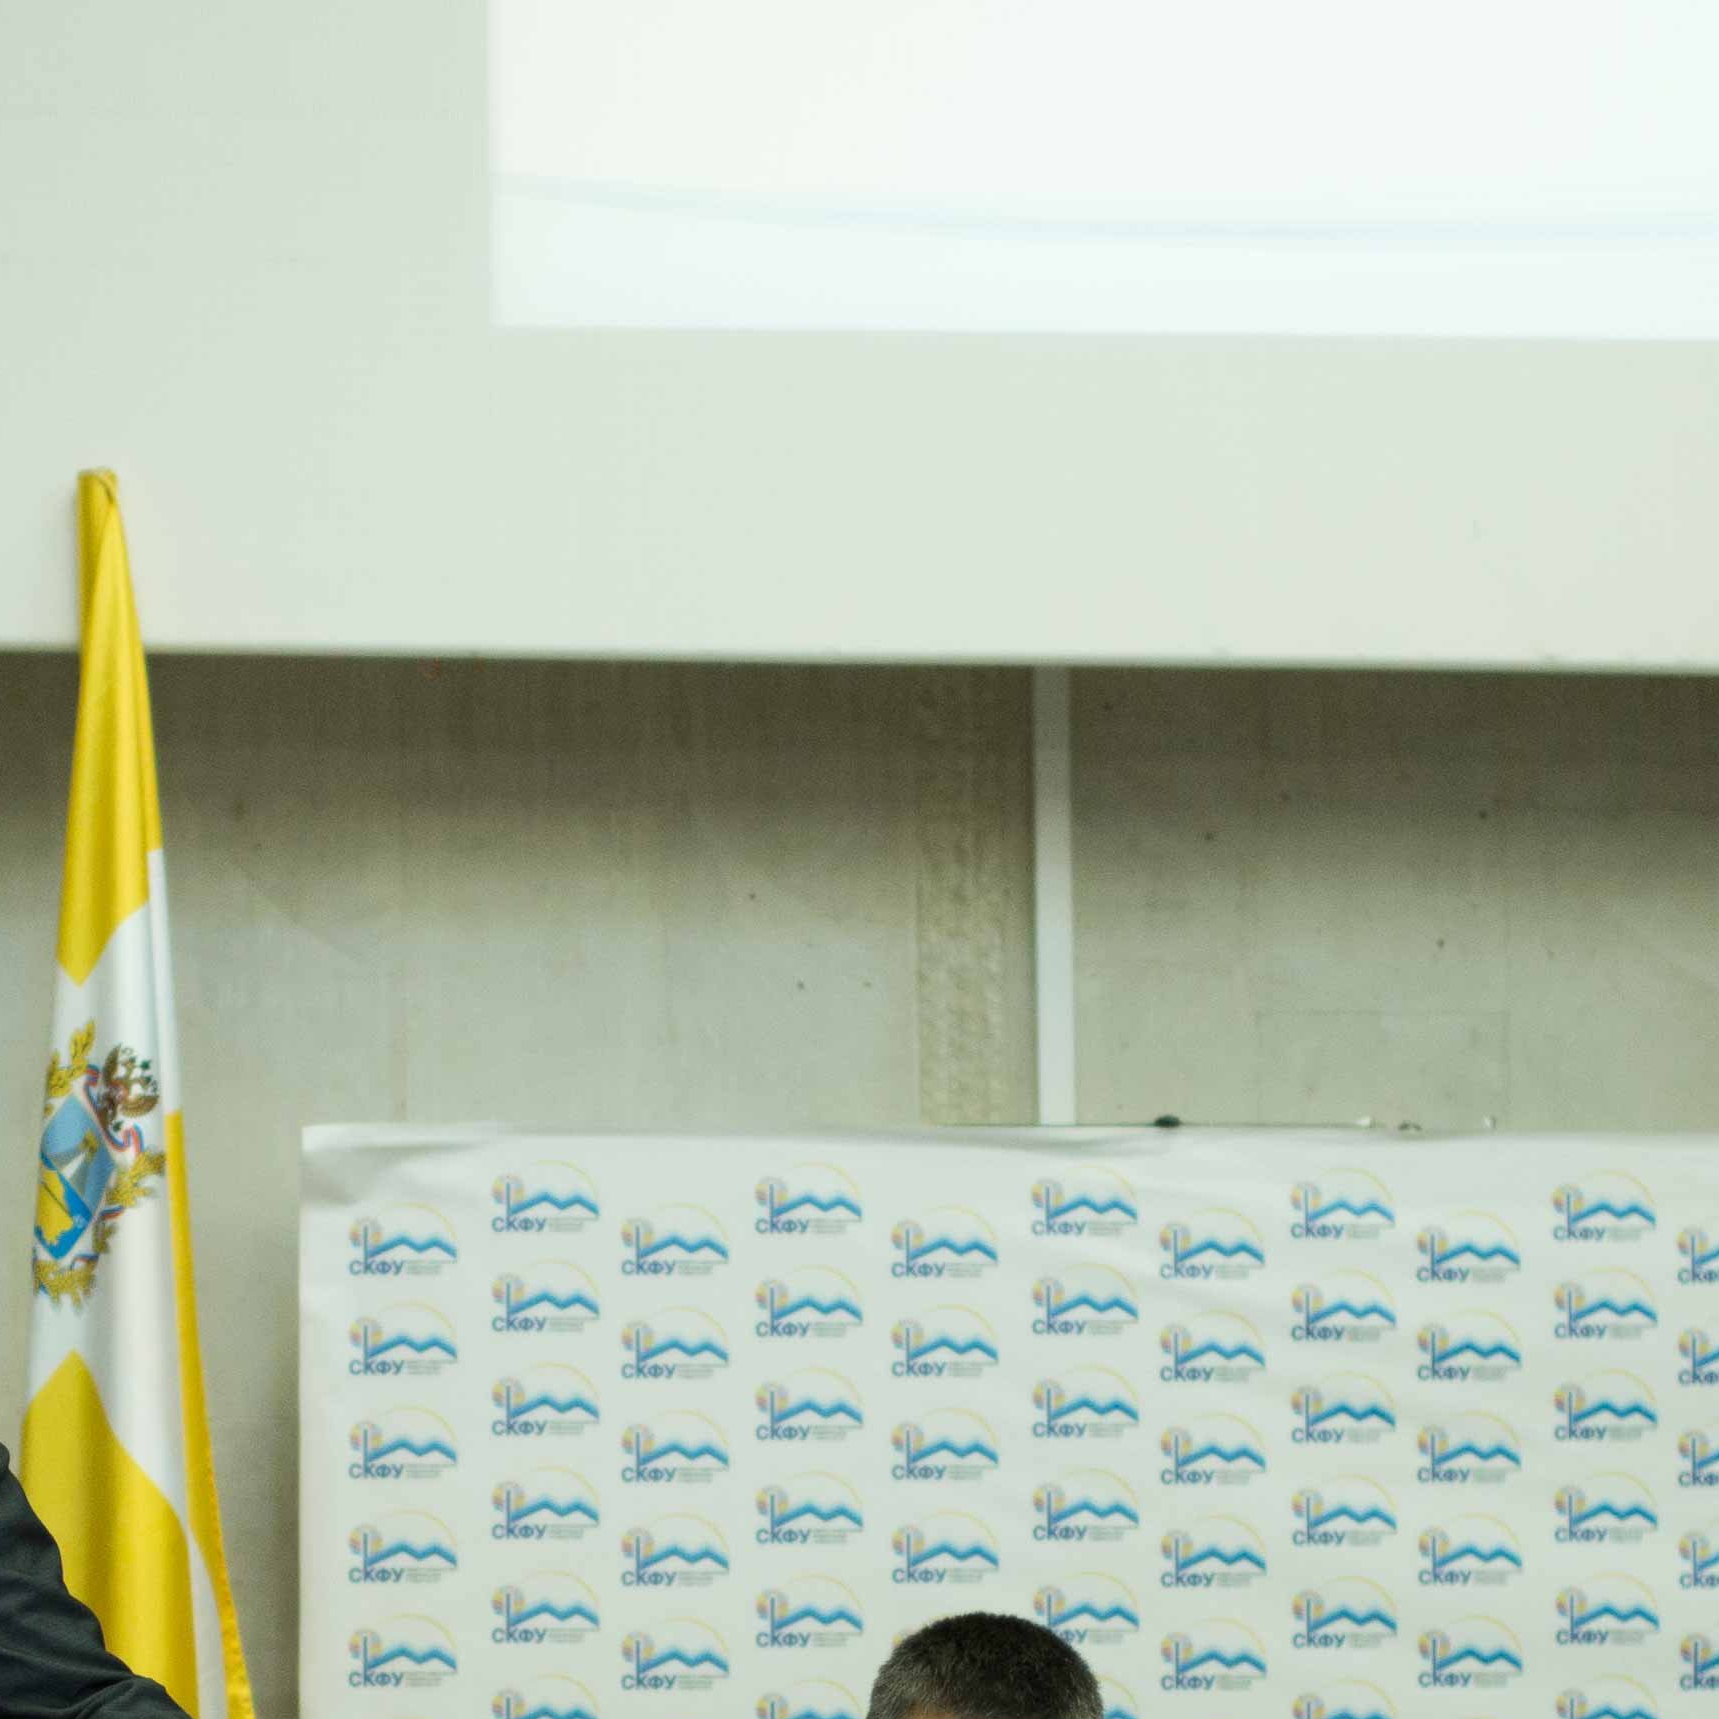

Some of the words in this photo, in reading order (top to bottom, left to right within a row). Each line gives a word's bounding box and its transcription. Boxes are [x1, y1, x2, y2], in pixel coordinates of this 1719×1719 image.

[492, 1216, 547, 1231] СКФУ
[755, 1218, 810, 1233] СКФУ
[1032, 1222, 1085, 1236] СКФУ
[1290, 1224, 1343, 1238] СКФУ
[1552, 1227, 1605, 1241] СКФУ
[349, 1259, 404, 1274] СКФУ
[621, 1260, 676, 1275] СКФУ
[891, 1262, 946, 1277] СКФУ
[1159, 1265, 1212, 1279] СКФУ
[1416, 1268, 1469, 1282] СКФУ
[492, 1316, 547, 1331] СКФУ
[756, 1321, 811, 1336] СКФУ
[1032, 1319, 1087, 1334] СКФУ
[349, 1359, 404, 1374] СКФУ
[621, 1363, 676, 1378] СКФУ
[892, 1362, 945, 1376] СКФУ
[492, 1420, 547, 1435] СКФУ
[756, 1425, 811, 1440] СКФУ
[1032, 1422, 1087, 1437] СКФУ
[1554, 1426, 1607, 1440] СКФУ
[1291, 1429, 1344, 1443] СКФУ
[349, 1463, 404, 1478] СКФУ
[622, 1466, 677, 1481] СКФУ
[892, 1464, 947, 1479] СКФУ
[1160, 1470, 1213, 1484] СКФУ
[1417, 1468, 1470, 1482] СКФУ
[492, 1523, 547, 1538] СКФУ
[756, 1528, 811, 1543] СКФУ
[1033, 1526, 1086, 1540] СКФУ
[349, 1567, 404, 1582] СКФУ
[622, 1570, 677, 1585] СКФУ
[892, 1567, 947, 1582] СКФУ
[492, 1627, 547, 1642] СКФУ
[756, 1631, 811, 1646] СКФУ
[1292, 1633, 1345, 1647] СКФУ
[1556, 1630, 1609, 1644] СКФУ
[349, 1671, 404, 1686] СКФУ
[622, 1674, 677, 1689] СКФУ
[1161, 1676, 1214, 1690] СКФУ
[1418, 1672, 1471, 1686] СКФУ
